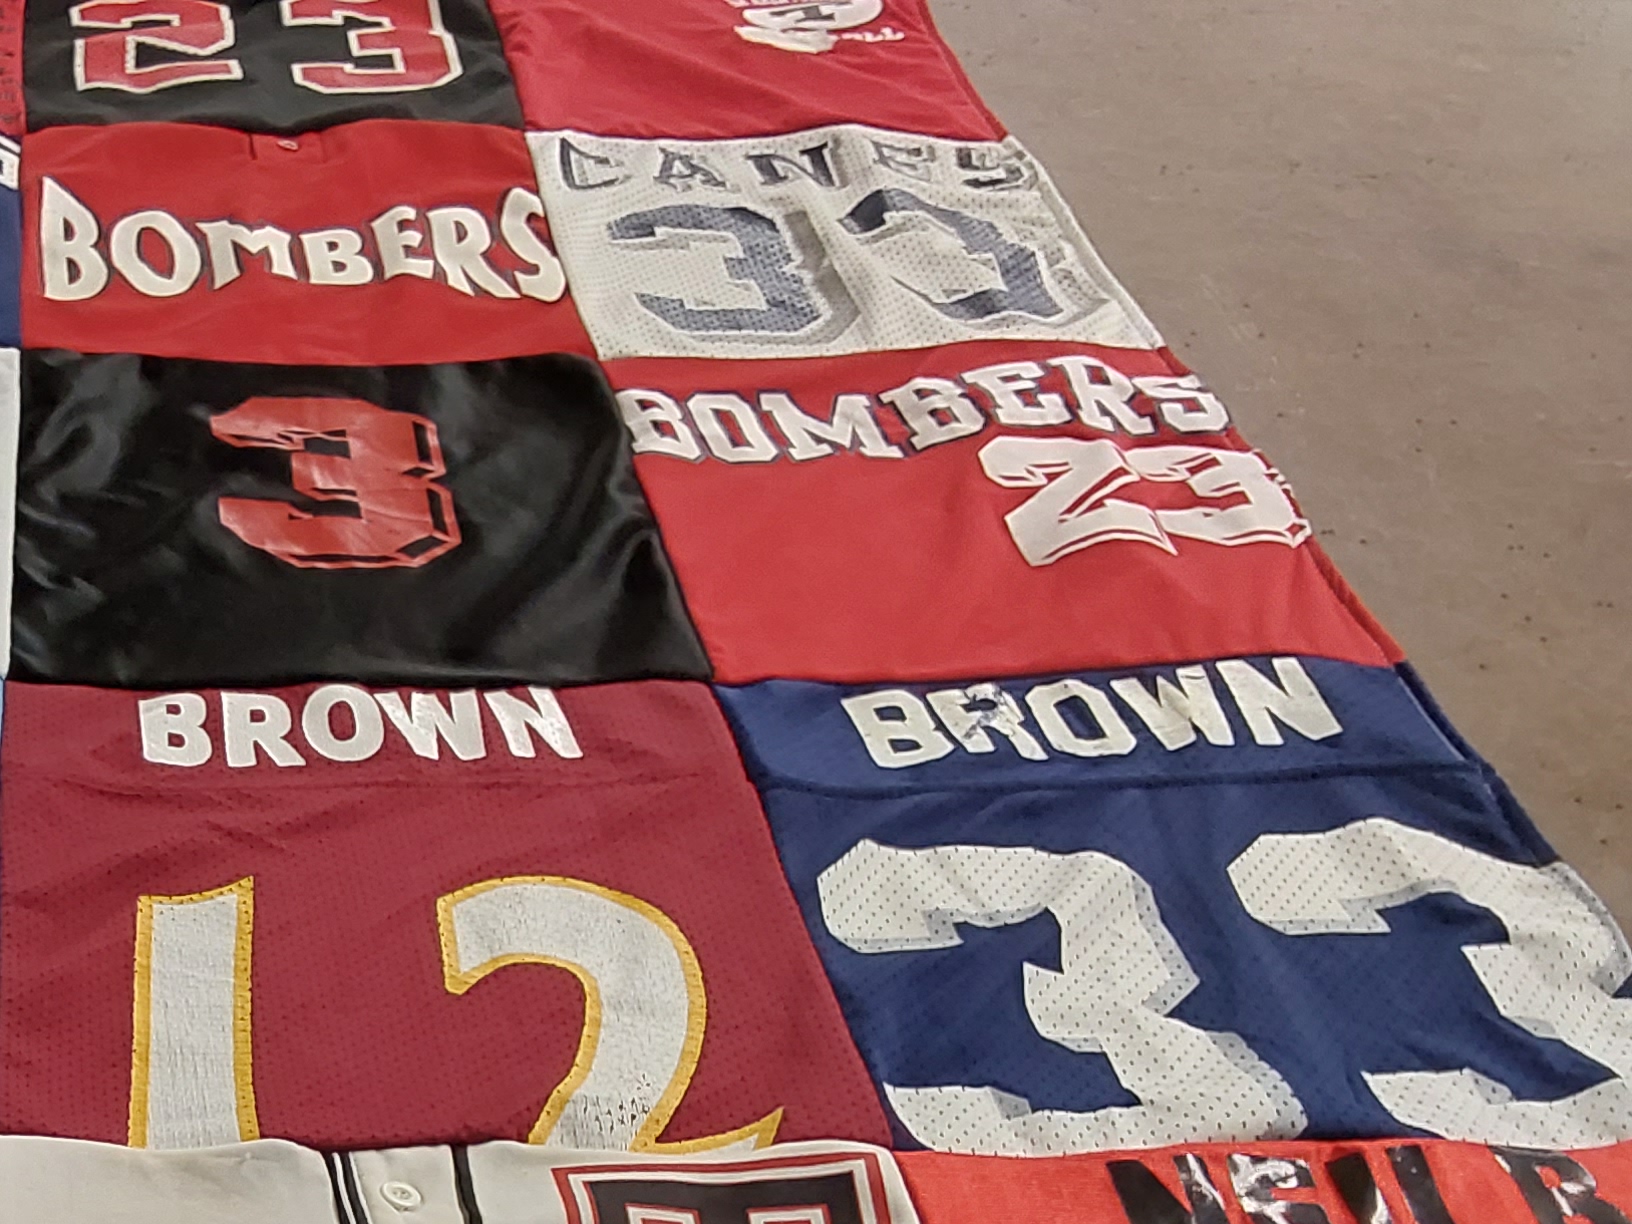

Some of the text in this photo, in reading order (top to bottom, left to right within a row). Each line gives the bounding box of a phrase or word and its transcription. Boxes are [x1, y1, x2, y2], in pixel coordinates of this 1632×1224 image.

[70, 0, 464, 94] 23
[558, 137, 1043, 192] CANES
[40, 176, 567, 302] BOMBERS
[615, 355, 1230, 463] BOMBERS
[210, 395, 462, 569] 3
[978, 435, 1313, 567] 23
[137, 684, 584, 768] BROWN
[840, 656, 1344, 769] BROWN
[128, 875, 785, 1153] 12
[817, 817, 1632, 1159] 33
